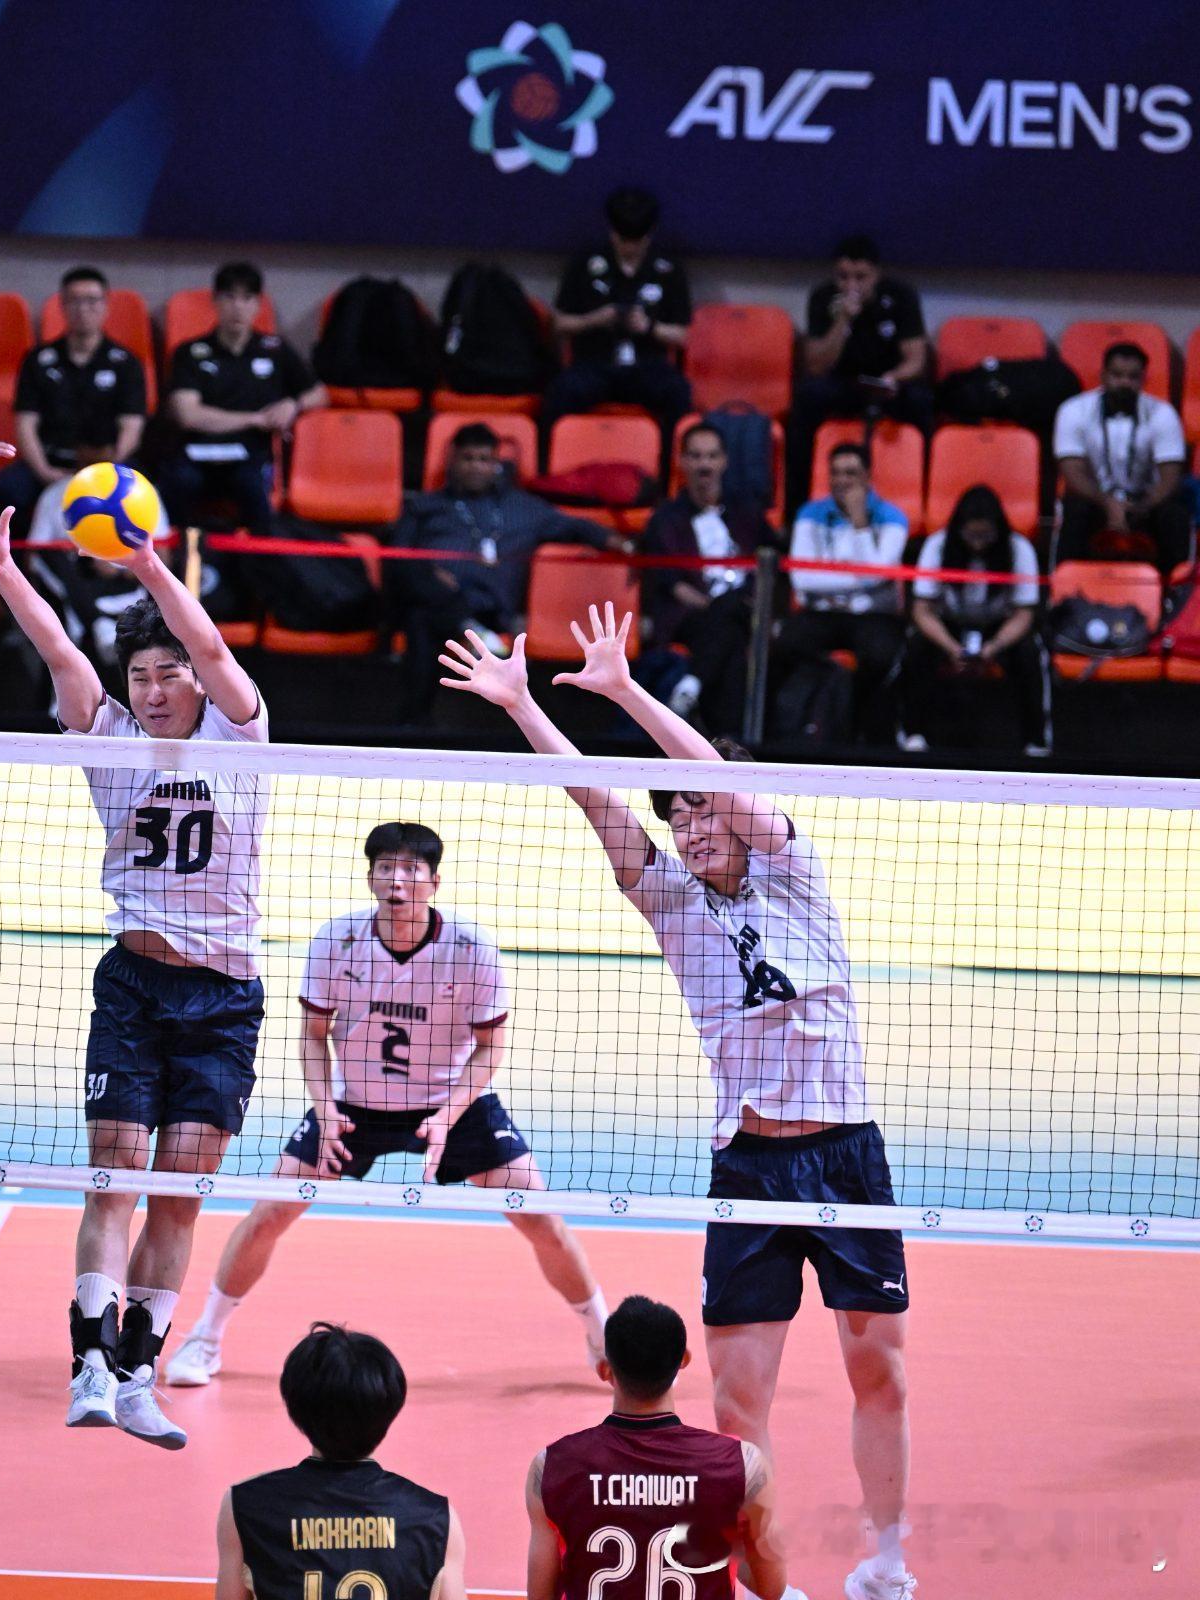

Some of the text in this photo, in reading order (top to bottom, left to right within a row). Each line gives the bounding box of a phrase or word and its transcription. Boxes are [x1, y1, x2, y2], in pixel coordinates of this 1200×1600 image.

[666, 65, 1194, 154] AVC MEN'S
[146, 779, 212, 802] UMA
[133, 806, 215, 875] 30
[369, 1000, 429, 1023] PUMA
[381, 1021, 411, 1077] 2
[86, 1073, 109, 1101] 30
[589, 1474, 699, 1507] T.CHAIWAT
[290, 1516, 396, 1551] I.NAKHARIN
